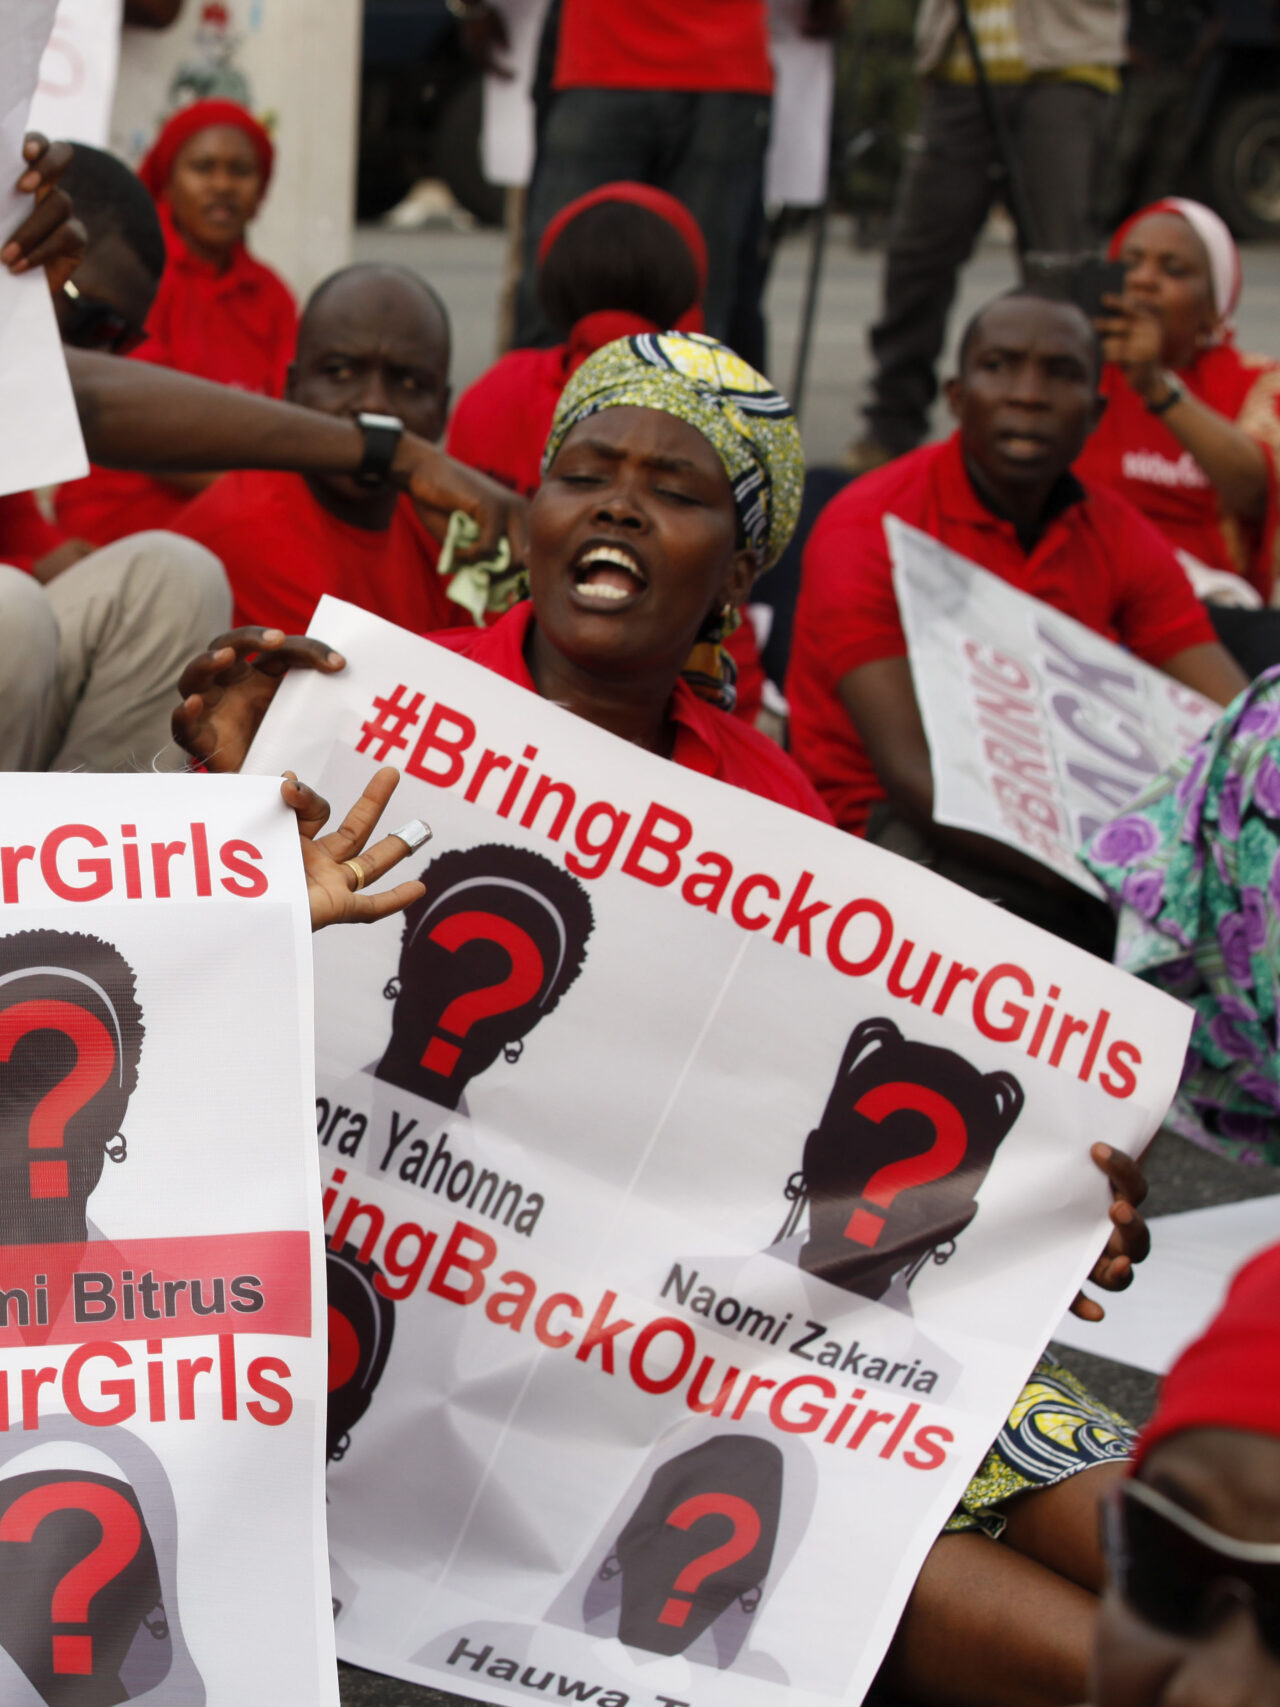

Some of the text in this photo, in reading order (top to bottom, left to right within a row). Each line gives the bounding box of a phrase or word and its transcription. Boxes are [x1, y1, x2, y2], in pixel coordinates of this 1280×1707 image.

[1037, 620, 1160, 846] ACK
[356, 683, 1142, 1098] #BringBackOurGirls
[380, 1110, 545, 1238] Yahonna
[73, 1270, 265, 1324] Bitrus
[660, 1263, 939, 1394] Naomi Zakaria
[446, 1637, 630, 1707] Hauwa
